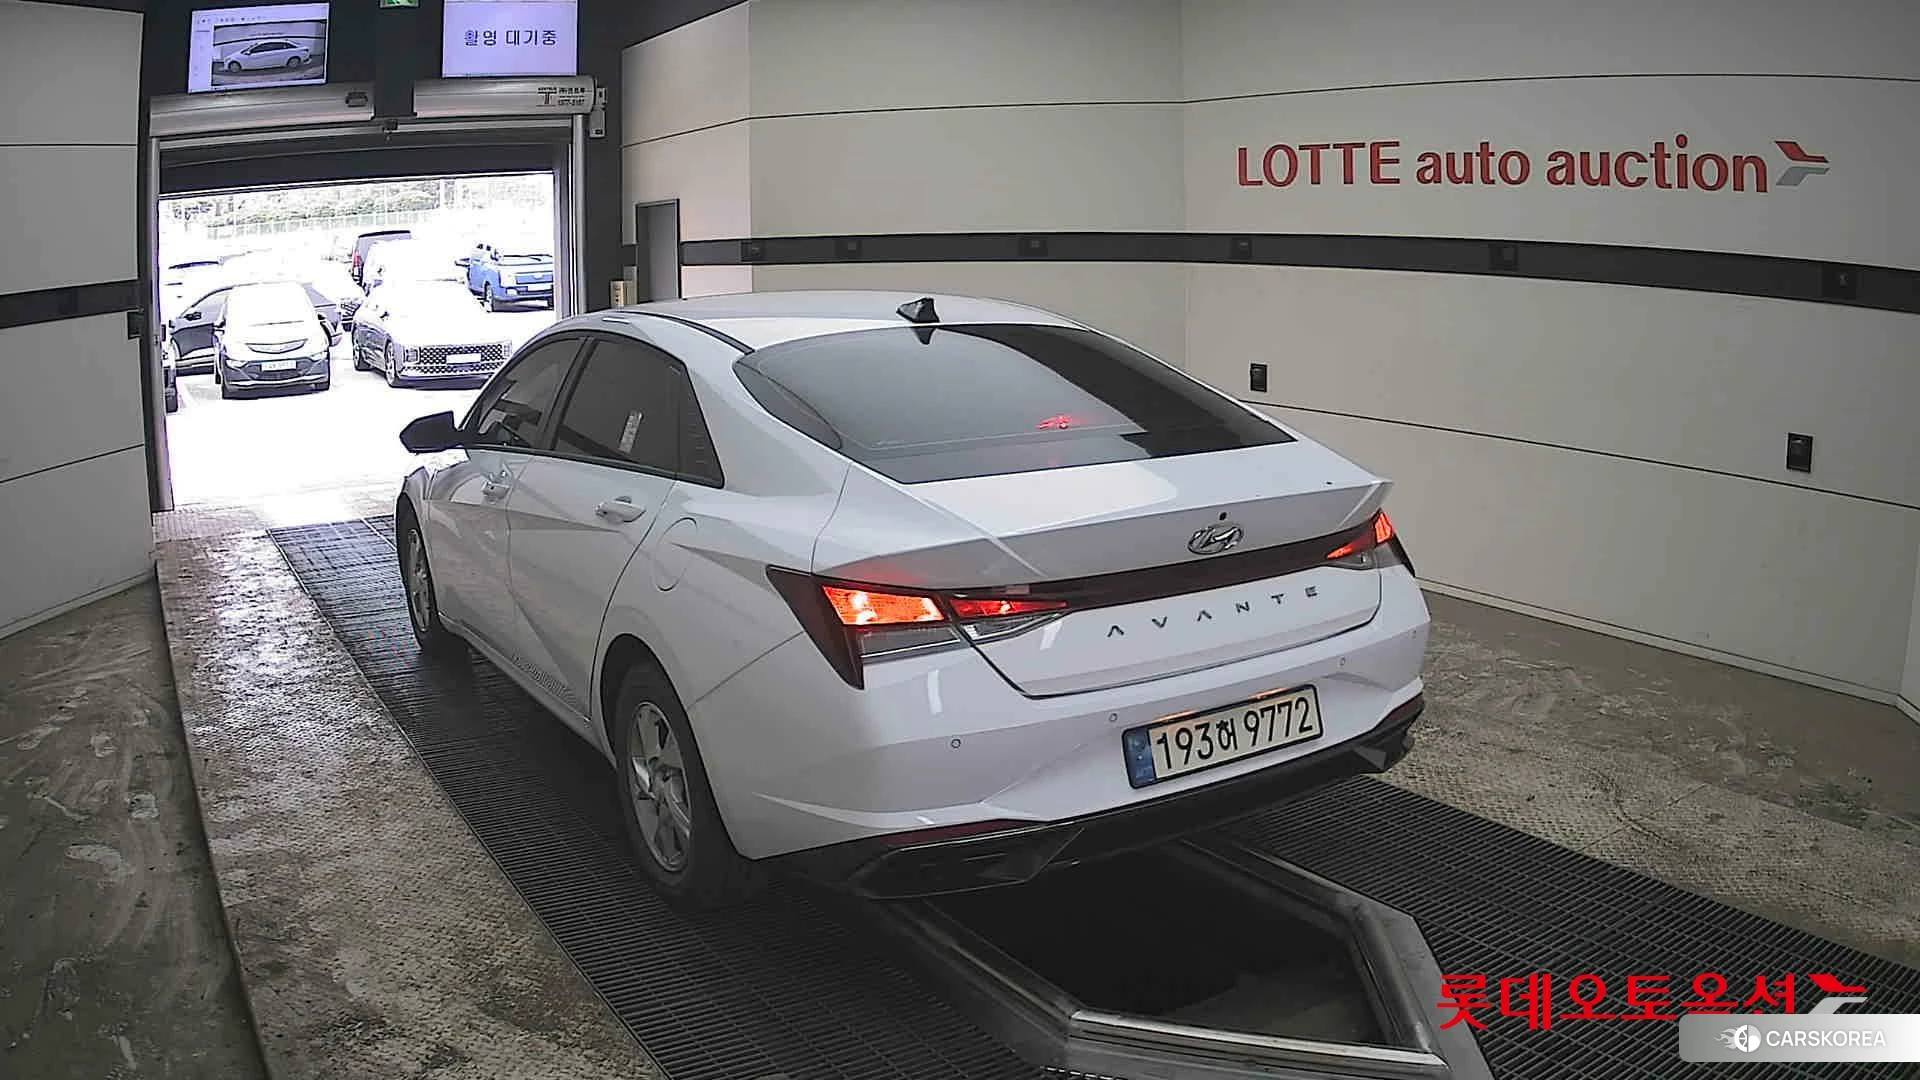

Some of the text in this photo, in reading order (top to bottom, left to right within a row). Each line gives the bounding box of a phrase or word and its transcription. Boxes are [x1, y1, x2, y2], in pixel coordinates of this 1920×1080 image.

[464, 29, 558, 47] 촬영 대기중
[1238, 134, 1768, 193] LOTTE auto auction
[1107, 585, 1318, 638] AVANTE
[1156, 696, 1314, 770] 193허 9772
